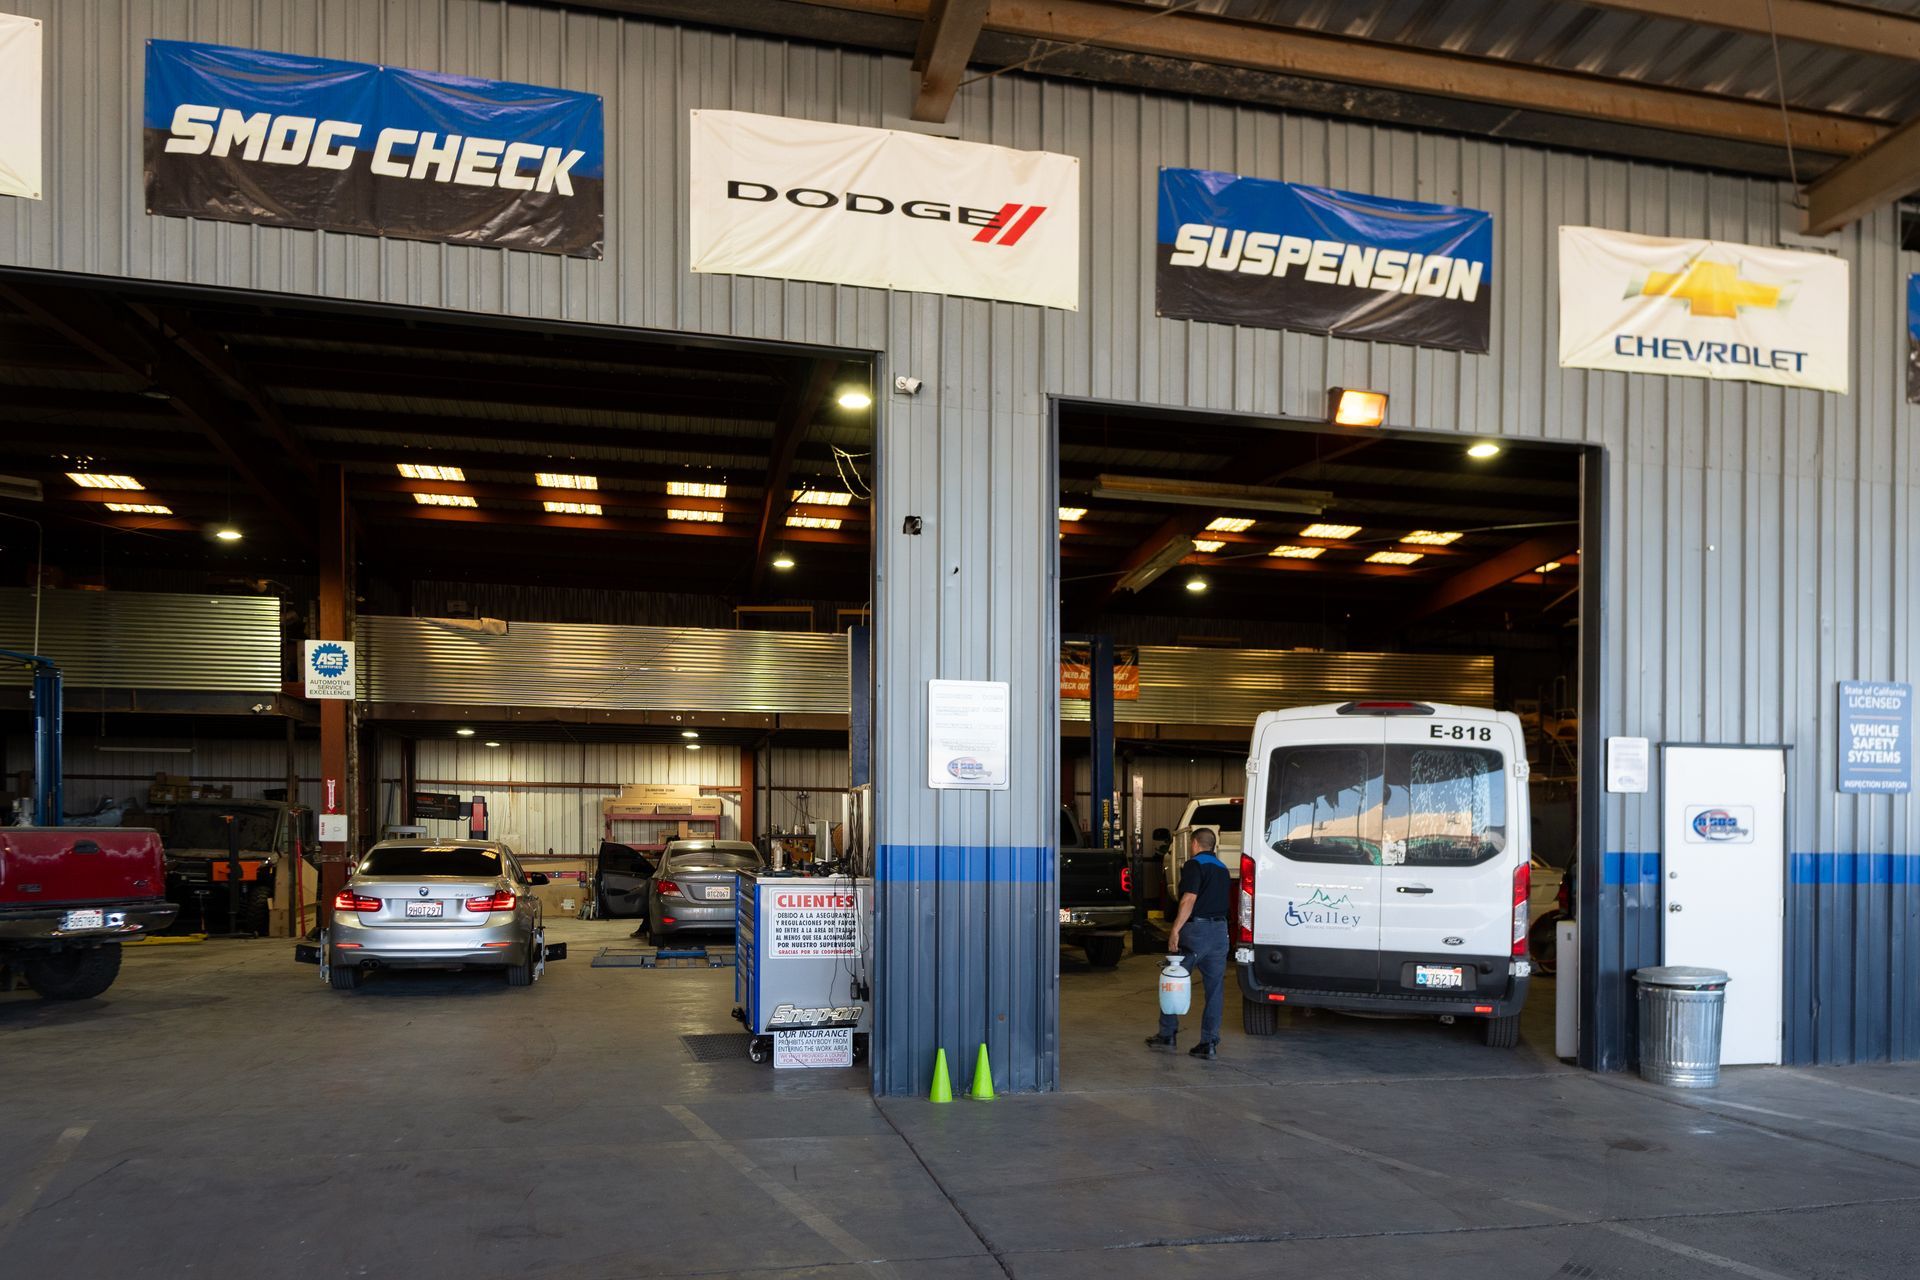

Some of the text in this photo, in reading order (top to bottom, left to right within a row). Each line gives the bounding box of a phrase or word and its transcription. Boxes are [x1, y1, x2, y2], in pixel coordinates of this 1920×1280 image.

[165, 104, 586, 196] SMOG CHECK
[727, 180, 1003, 229] DODGE
[1170, 223, 1483, 302] SUSPENSION
[1615, 334, 1808, 373] CHEVROLET
[316, 653, 343, 665] ASE
[1060, 682, 1077, 690] HECK
[1844, 685, 1907, 697] State of California
[1849, 696, 1901, 710] LICENSED
[1430, 724, 1492, 741] E-818
[1850, 723, 1899, 737] VEHICLE
[1852, 737, 1897, 750] SAFETY
[1848, 750, 1901, 764] SYSTEMS
[1844, 780, 1908, 789] INSPECTION STATION
[777, 895, 855, 907] CLIENTES
[1303, 911, 1361, 927] Valley
[770, 1003, 863, 1026] Snap-on
[778, 1029, 849, 1039] OUR INSURANCE
